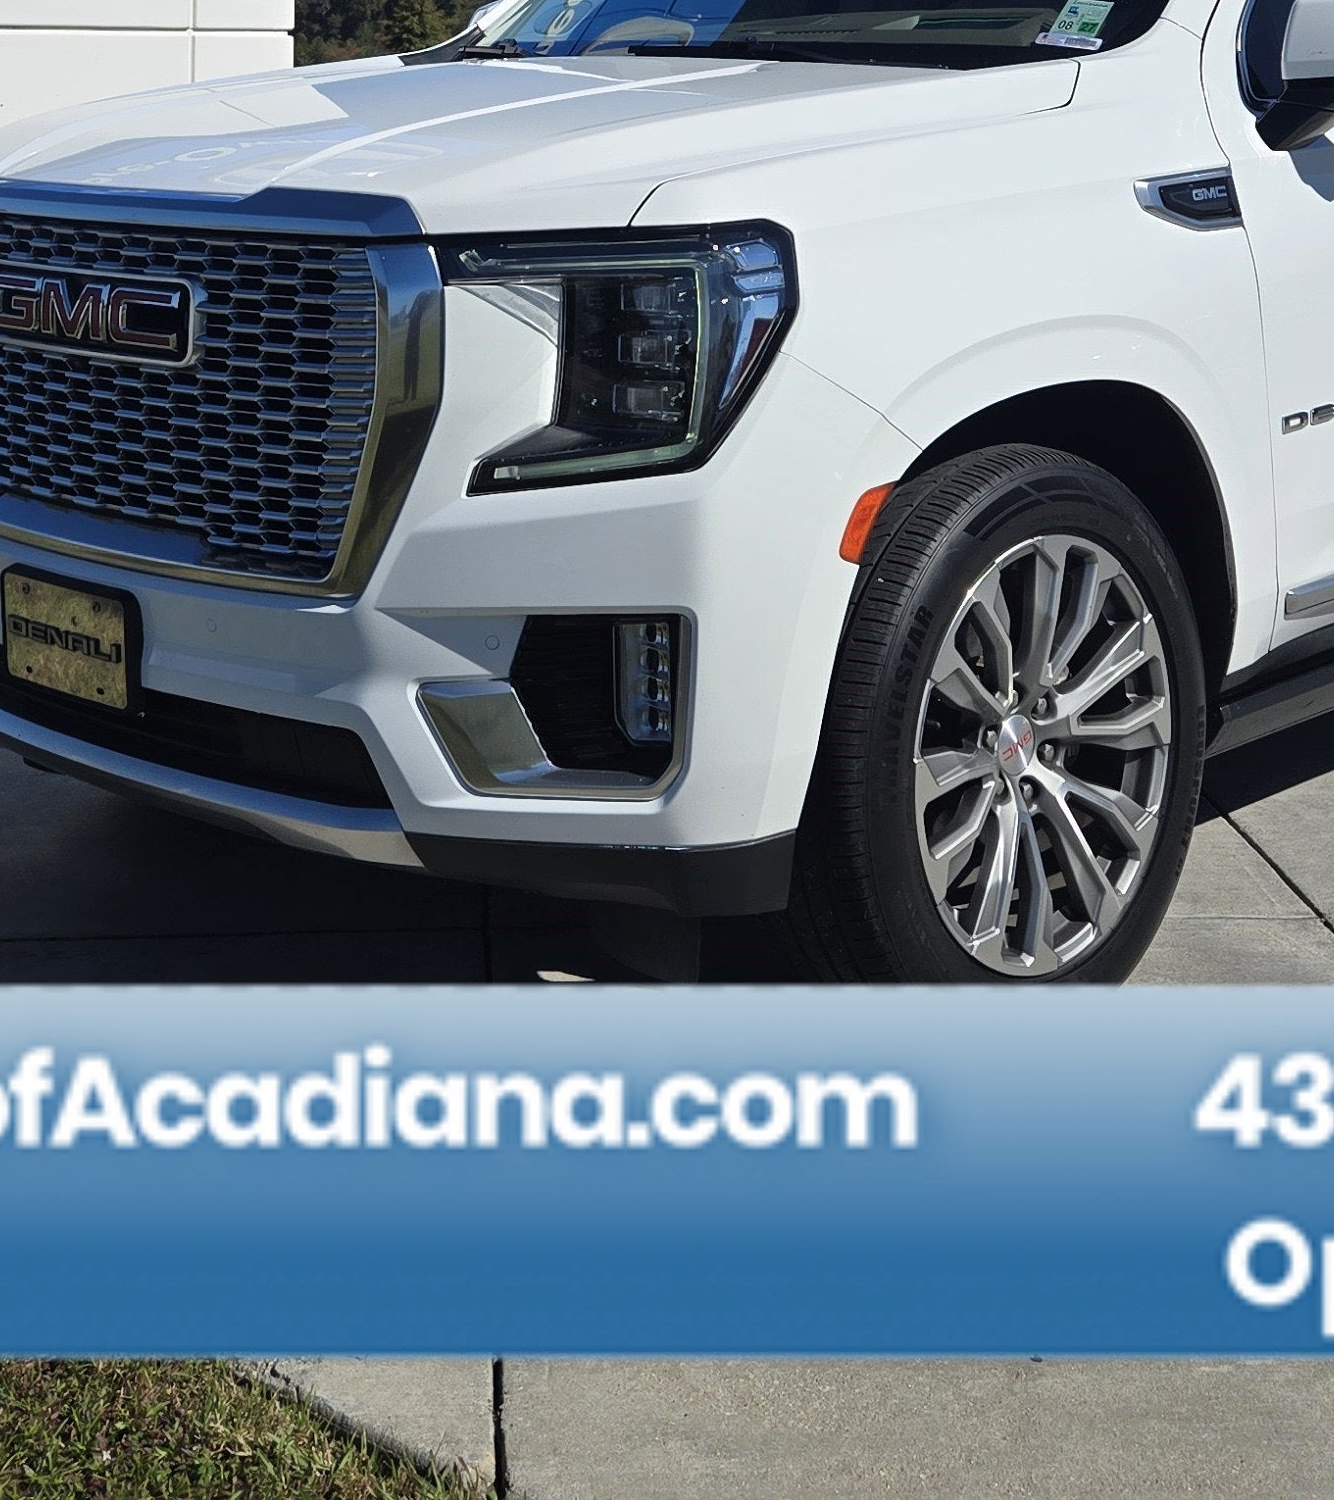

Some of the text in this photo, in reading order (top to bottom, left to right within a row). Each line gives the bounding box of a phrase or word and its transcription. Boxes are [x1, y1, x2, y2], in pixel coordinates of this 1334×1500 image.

[1192, 186, 1228, 202] GMC
[7, 613, 122, 665] DENALI
[1002, 730, 1032, 762] GMC
